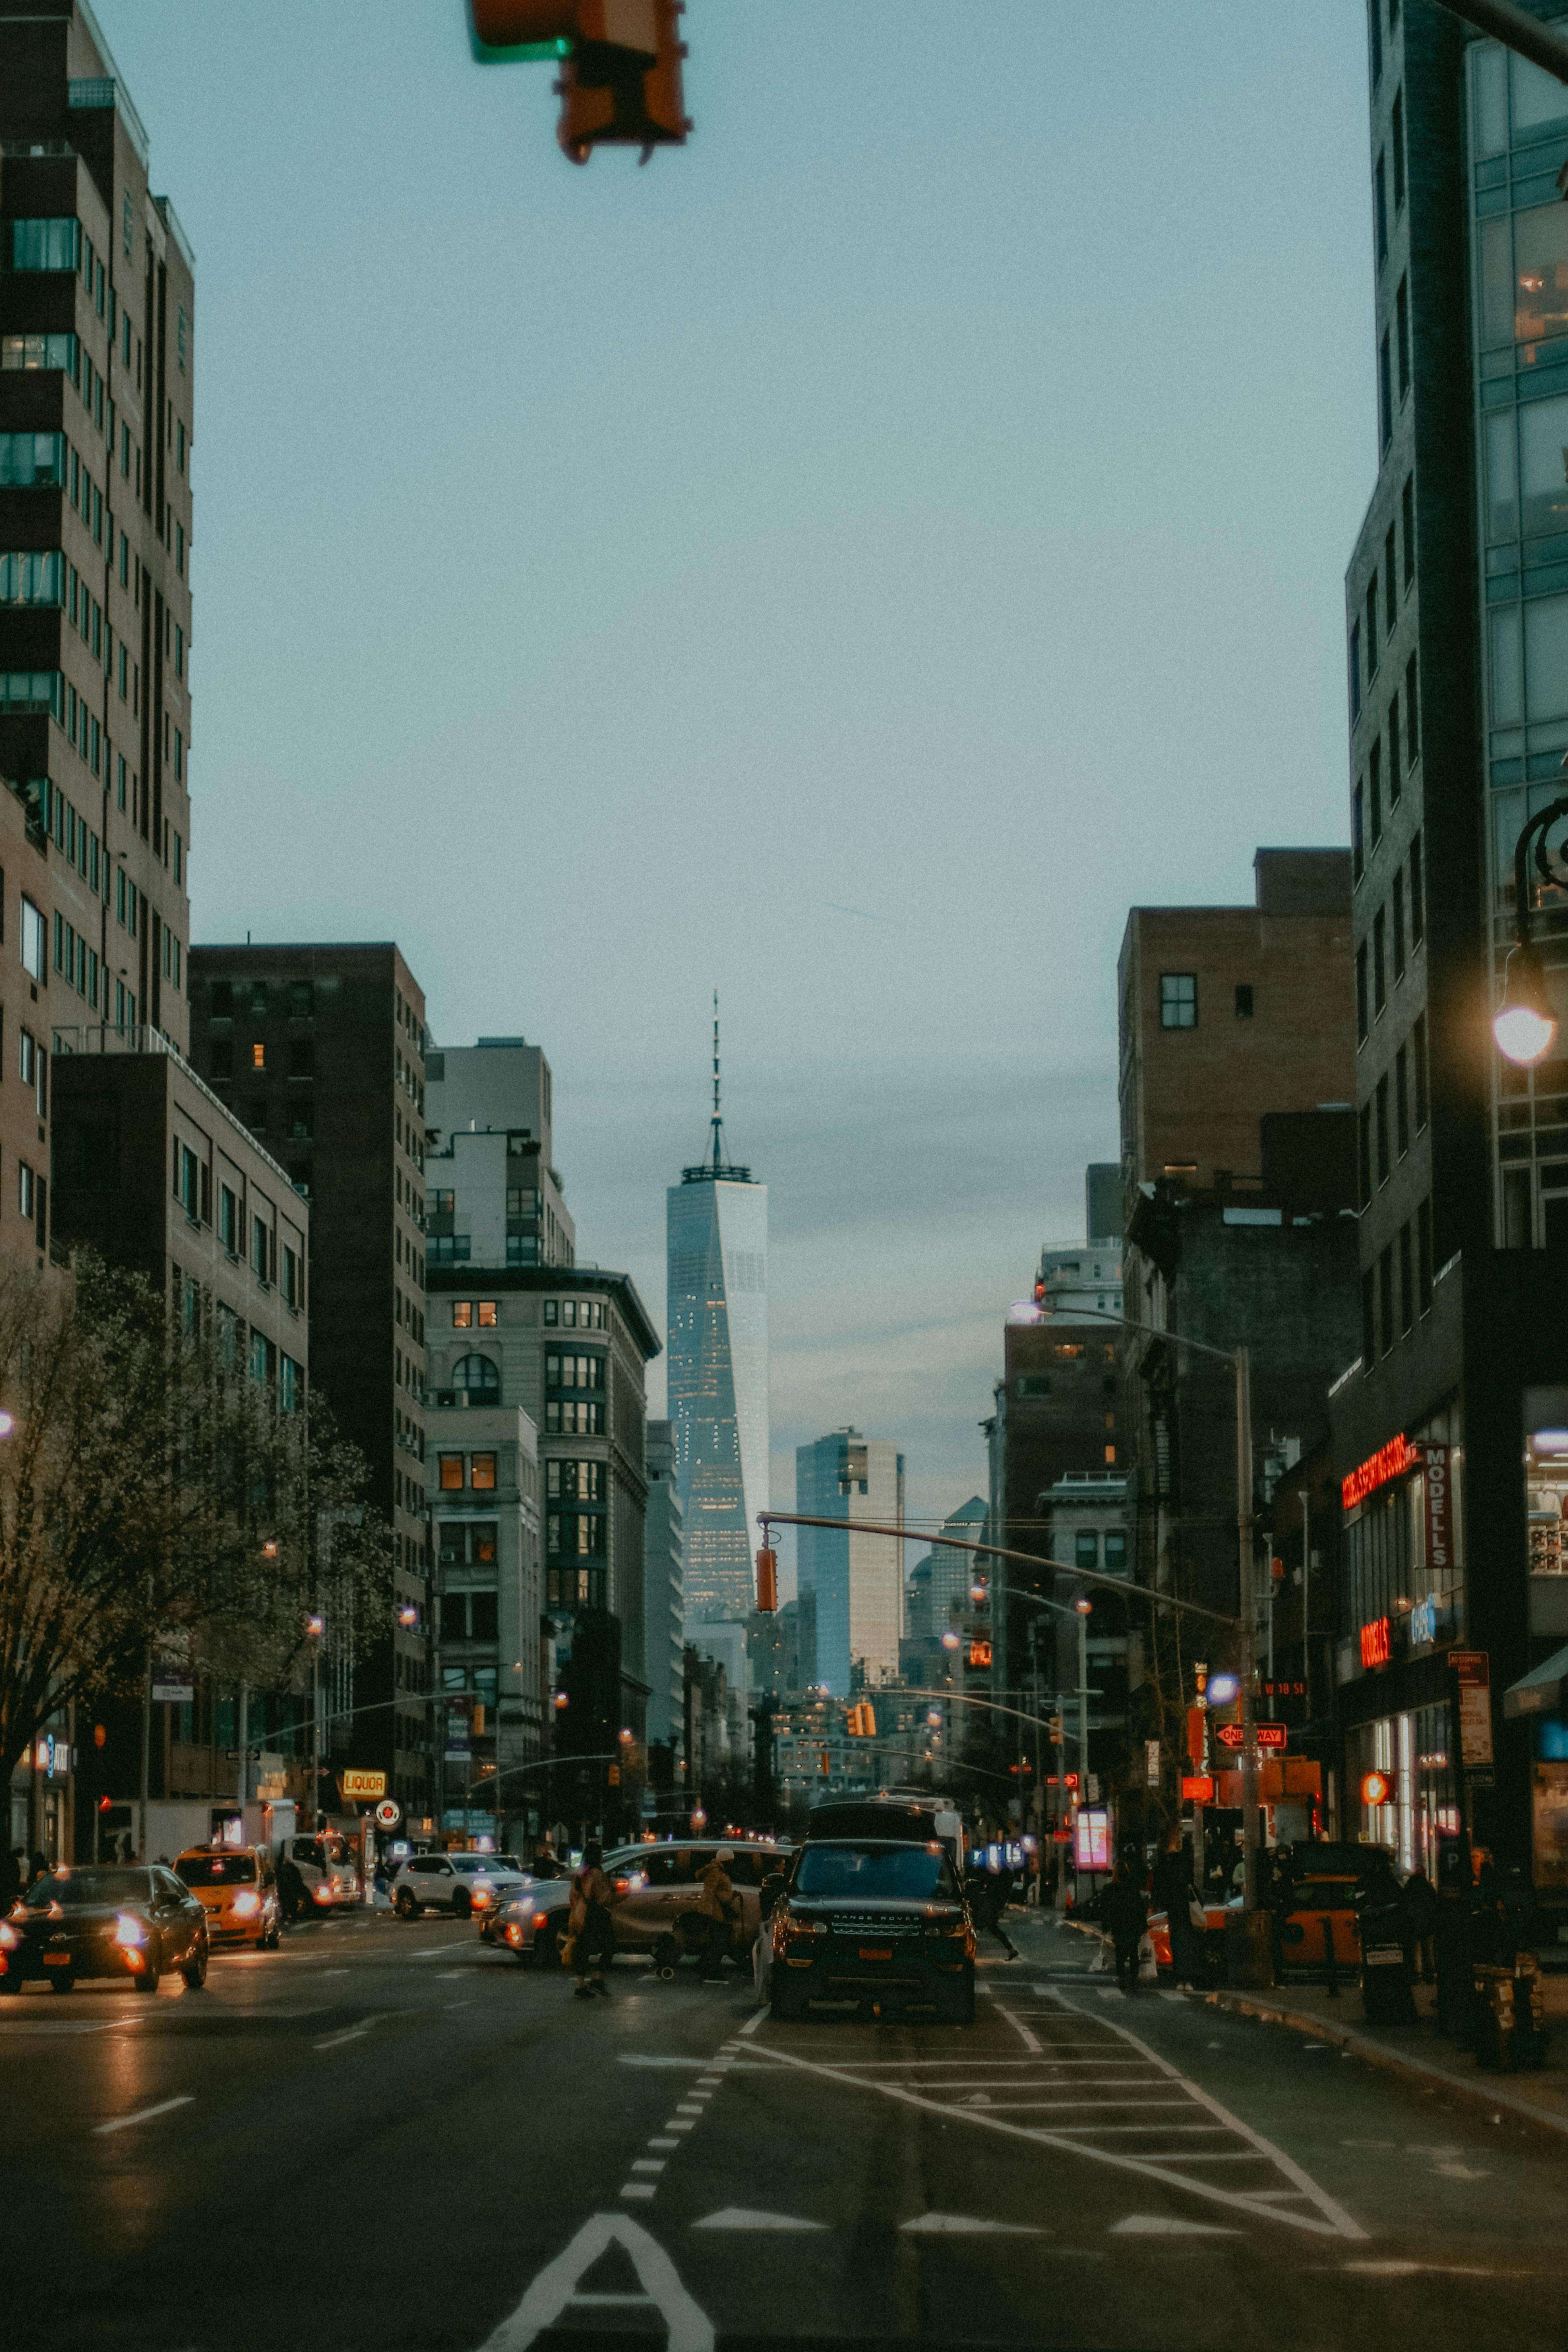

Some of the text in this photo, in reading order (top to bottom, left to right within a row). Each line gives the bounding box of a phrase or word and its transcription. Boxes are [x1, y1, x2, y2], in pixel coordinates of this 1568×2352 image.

[1427, 1449, 1446, 1566] MODELLS
[1265, 1683, 1274, 1694] W
[1278, 1683, 1289, 1694] 18
[1224, 1730, 1278, 1740] ONE WAY
[345, 1776, 383, 1790] LIQUOR
